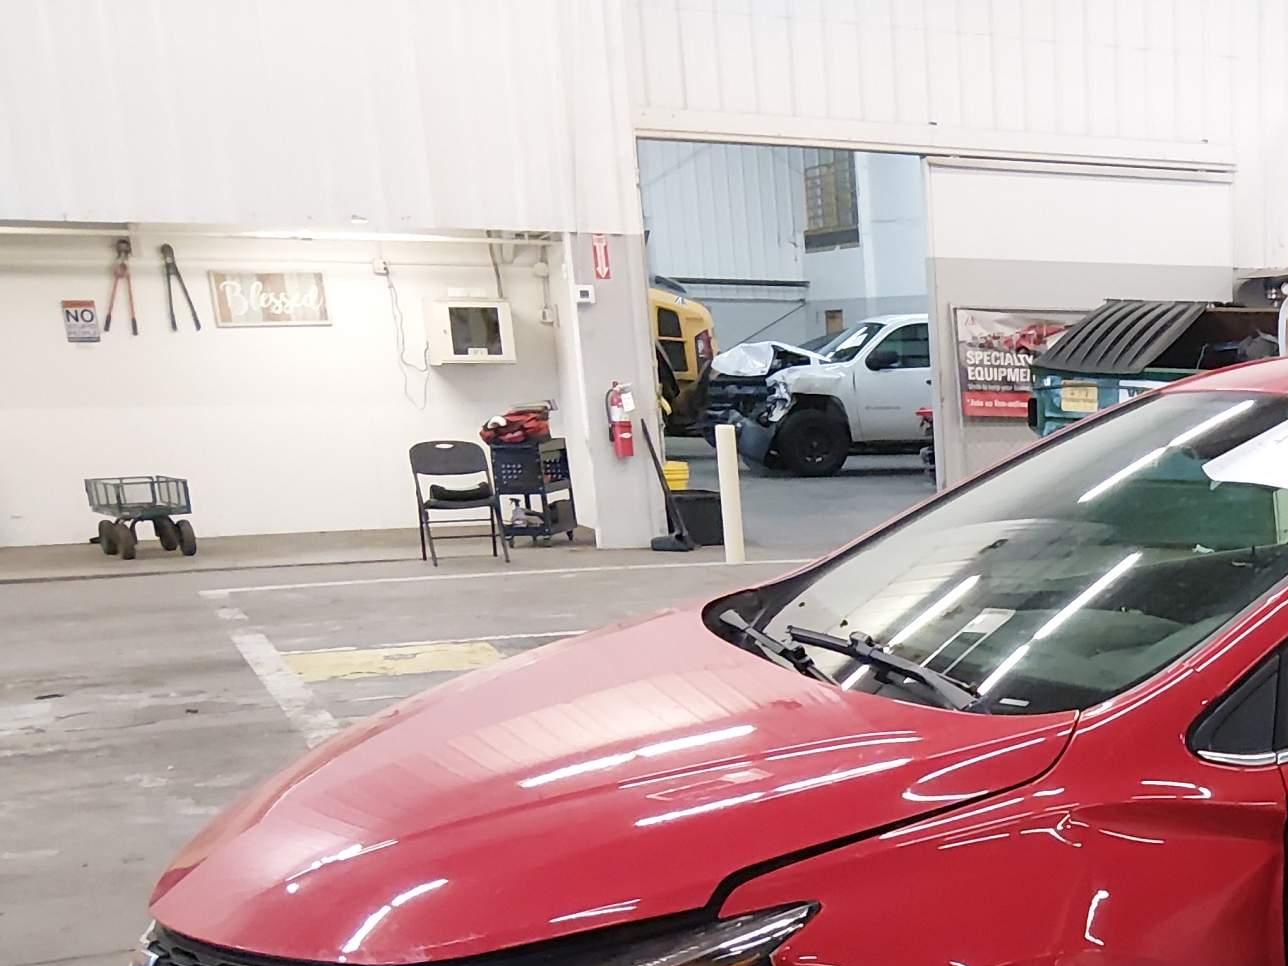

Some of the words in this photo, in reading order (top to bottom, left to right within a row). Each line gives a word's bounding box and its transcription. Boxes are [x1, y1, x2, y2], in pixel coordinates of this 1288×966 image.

[220, 281, 323, 316] Blessed
[65, 309, 95, 323] NO
[966, 350, 1034, 366] SPECIALTY
